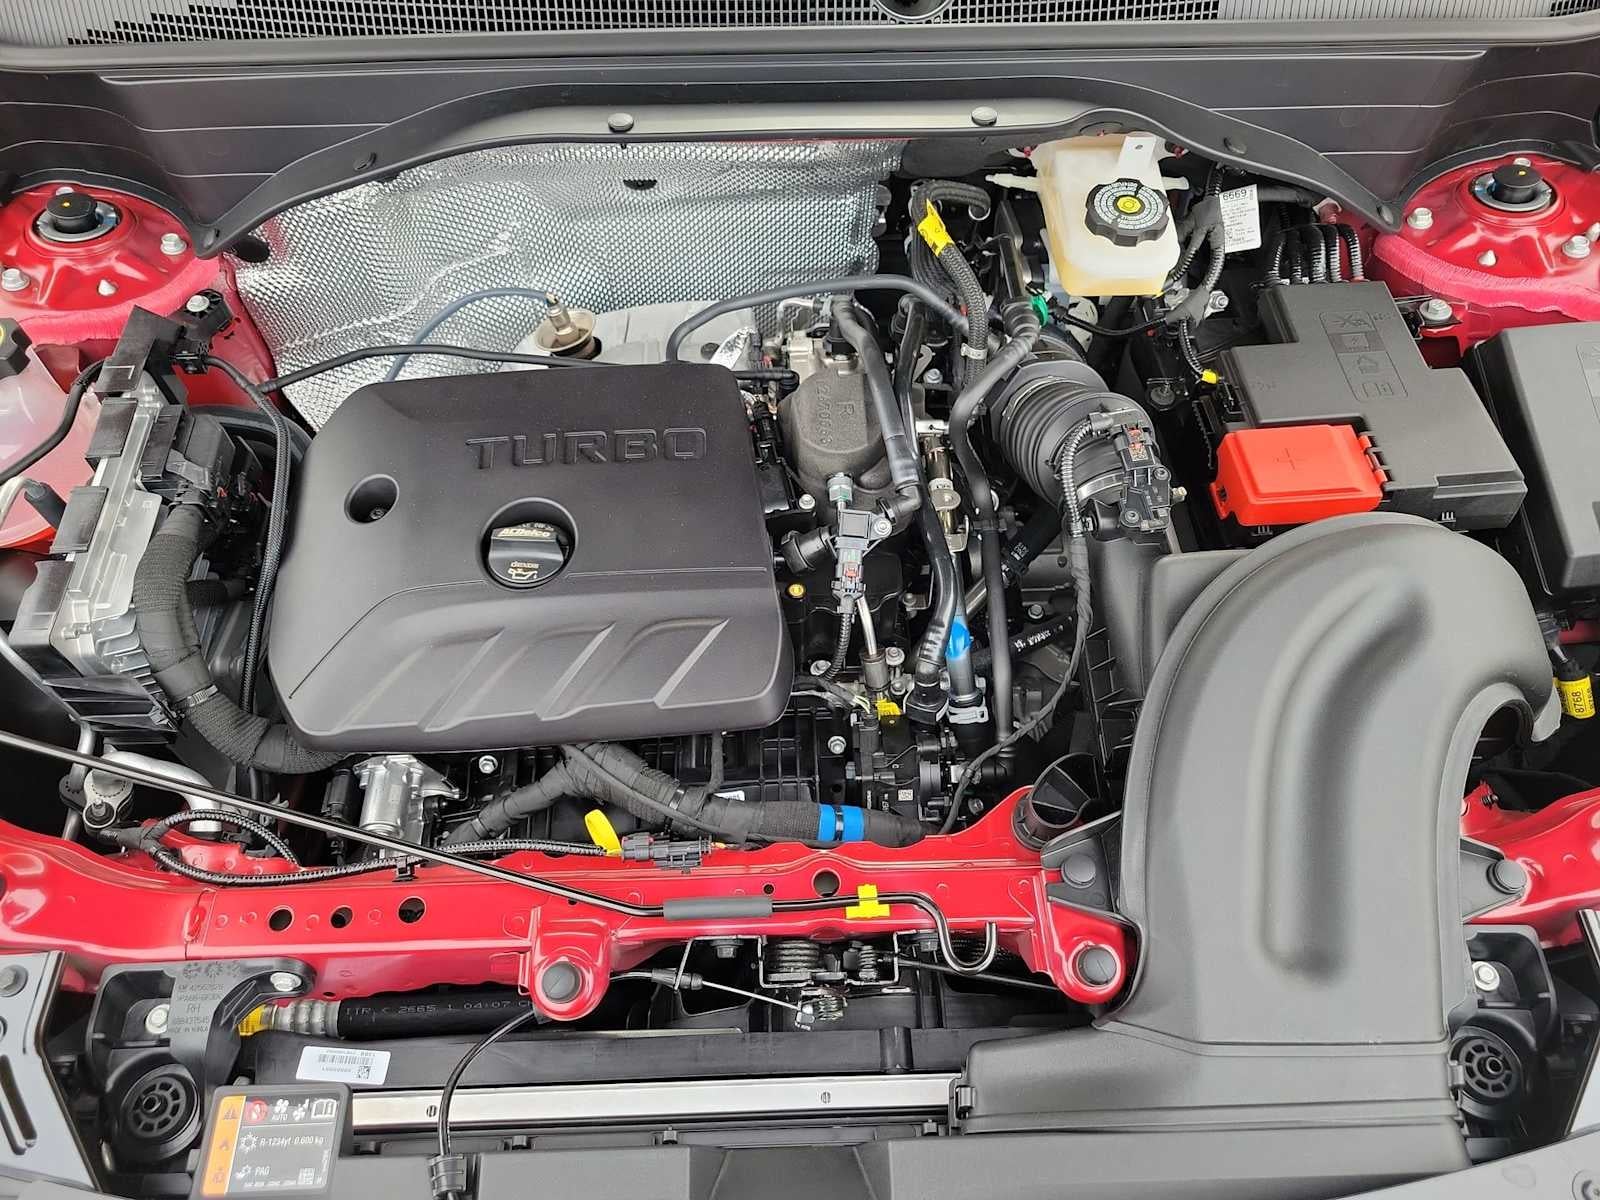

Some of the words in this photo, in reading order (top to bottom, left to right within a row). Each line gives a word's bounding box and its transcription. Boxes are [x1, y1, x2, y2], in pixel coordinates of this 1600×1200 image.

[466, 427, 706, 469] TURBO
[497, 528, 551, 538] ACDelco
[1571, 691, 1585, 713] 8768
[255, 1166, 271, 1176] PAG
